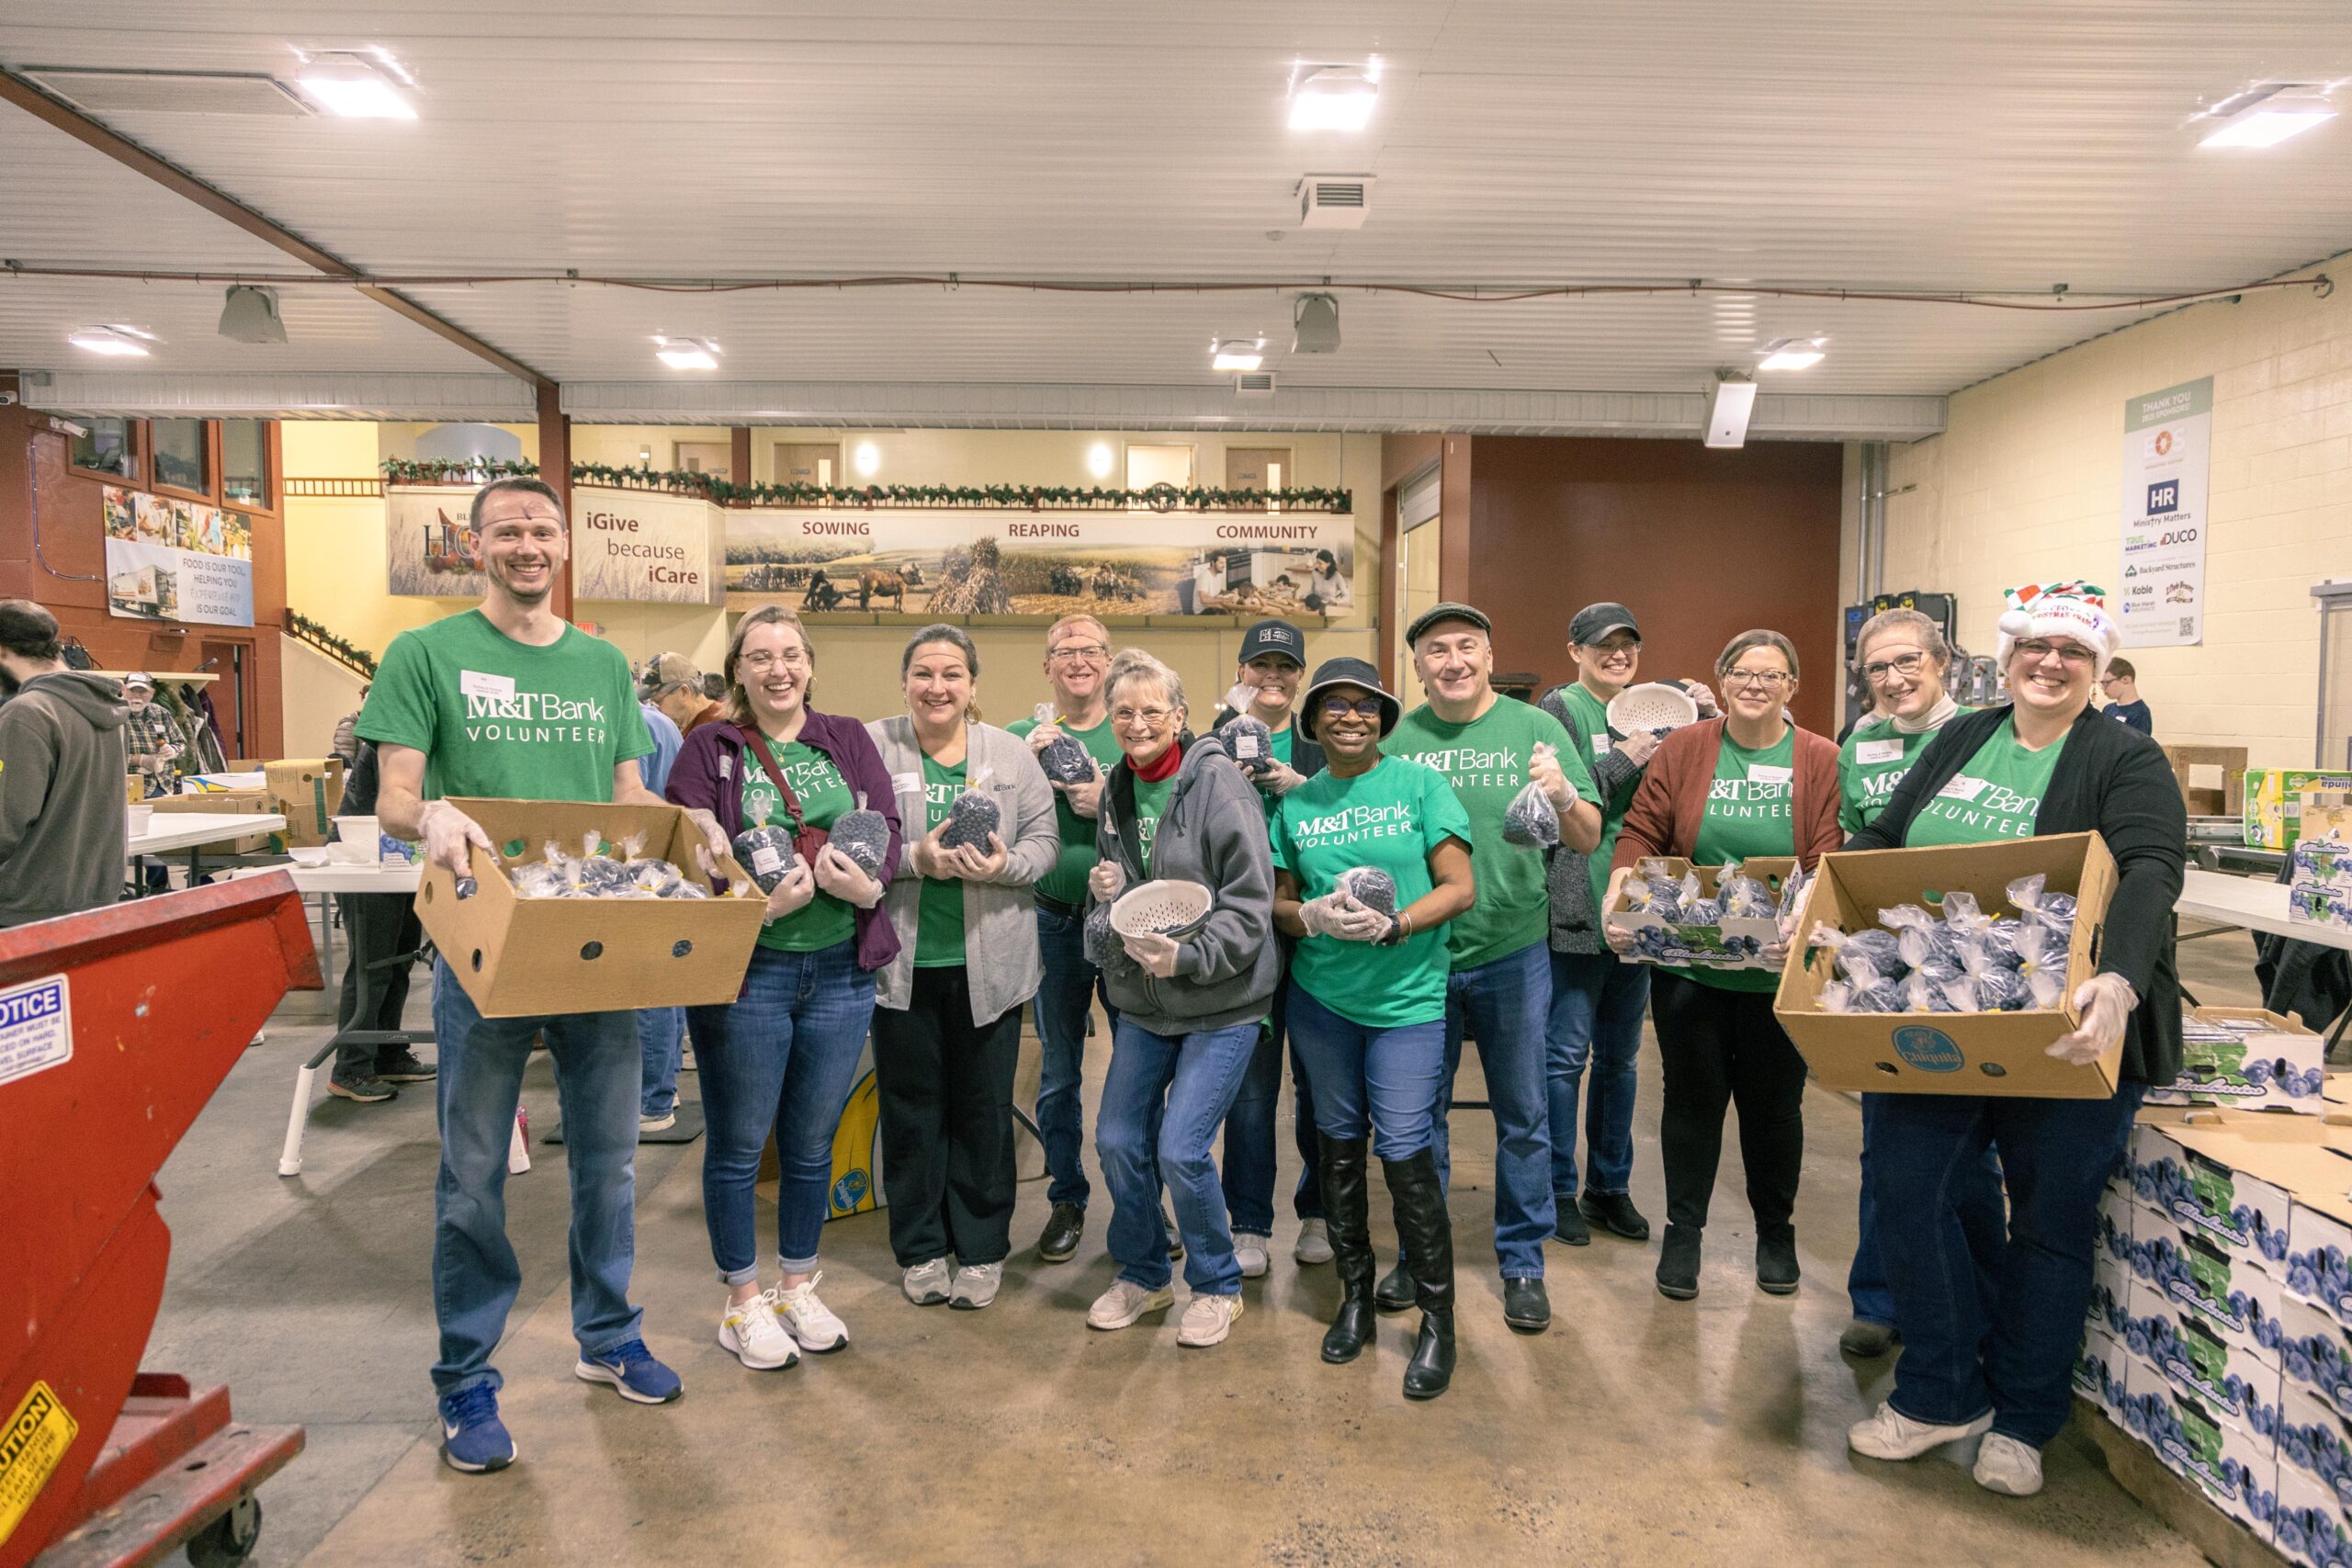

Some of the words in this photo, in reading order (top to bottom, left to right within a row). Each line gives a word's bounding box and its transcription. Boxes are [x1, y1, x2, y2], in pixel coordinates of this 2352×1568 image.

[2143, 397, 2171, 413] THANK
[2172, 390, 2191, 404] YOU
[2151, 487, 2175, 508] HR
[586, 512, 639, 532] iGive
[802, 522, 870, 536] SOWING
[1009, 524, 1080, 537] REAPING
[2133, 517, 2162, 528] Ministry
[2164, 513, 2191, 523] Matters
[1216, 525, 1318, 539] COMMUNITY
[2164, 528, 2198, 545] DUCO
[607, 537, 684, 560] because
[183, 558, 204, 570] FOOD
[205, 561, 211, 570] IS
[212, 563, 227, 573] OUR
[649, 566, 698, 585] iCare
[194, 574, 223, 587] HELPING
[224, 579, 238, 588] YOU
[197, 604, 203, 614] IS
[203, 604, 219, 615] OUR
[220, 606, 237, 617] GOAL
[542, 694, 605, 723] Bank
[466, 725, 605, 744] VOLUNTEER
[1459, 747, 1518, 770] Bank
[1452, 774, 1519, 788] NTEER
[1708, 778, 1747, 800] &T
[925, 783, 952, 804] &T
[1983, 786, 2040, 818] Ban
[1354, 800, 1410, 827] Bank
[1709, 804, 1792, 818] LUNTEE
[1295, 820, 1412, 852] VOLUNTEER
[0, 988, 58, 1027] OTICE
[0, 1395, 49, 1468] UTION
